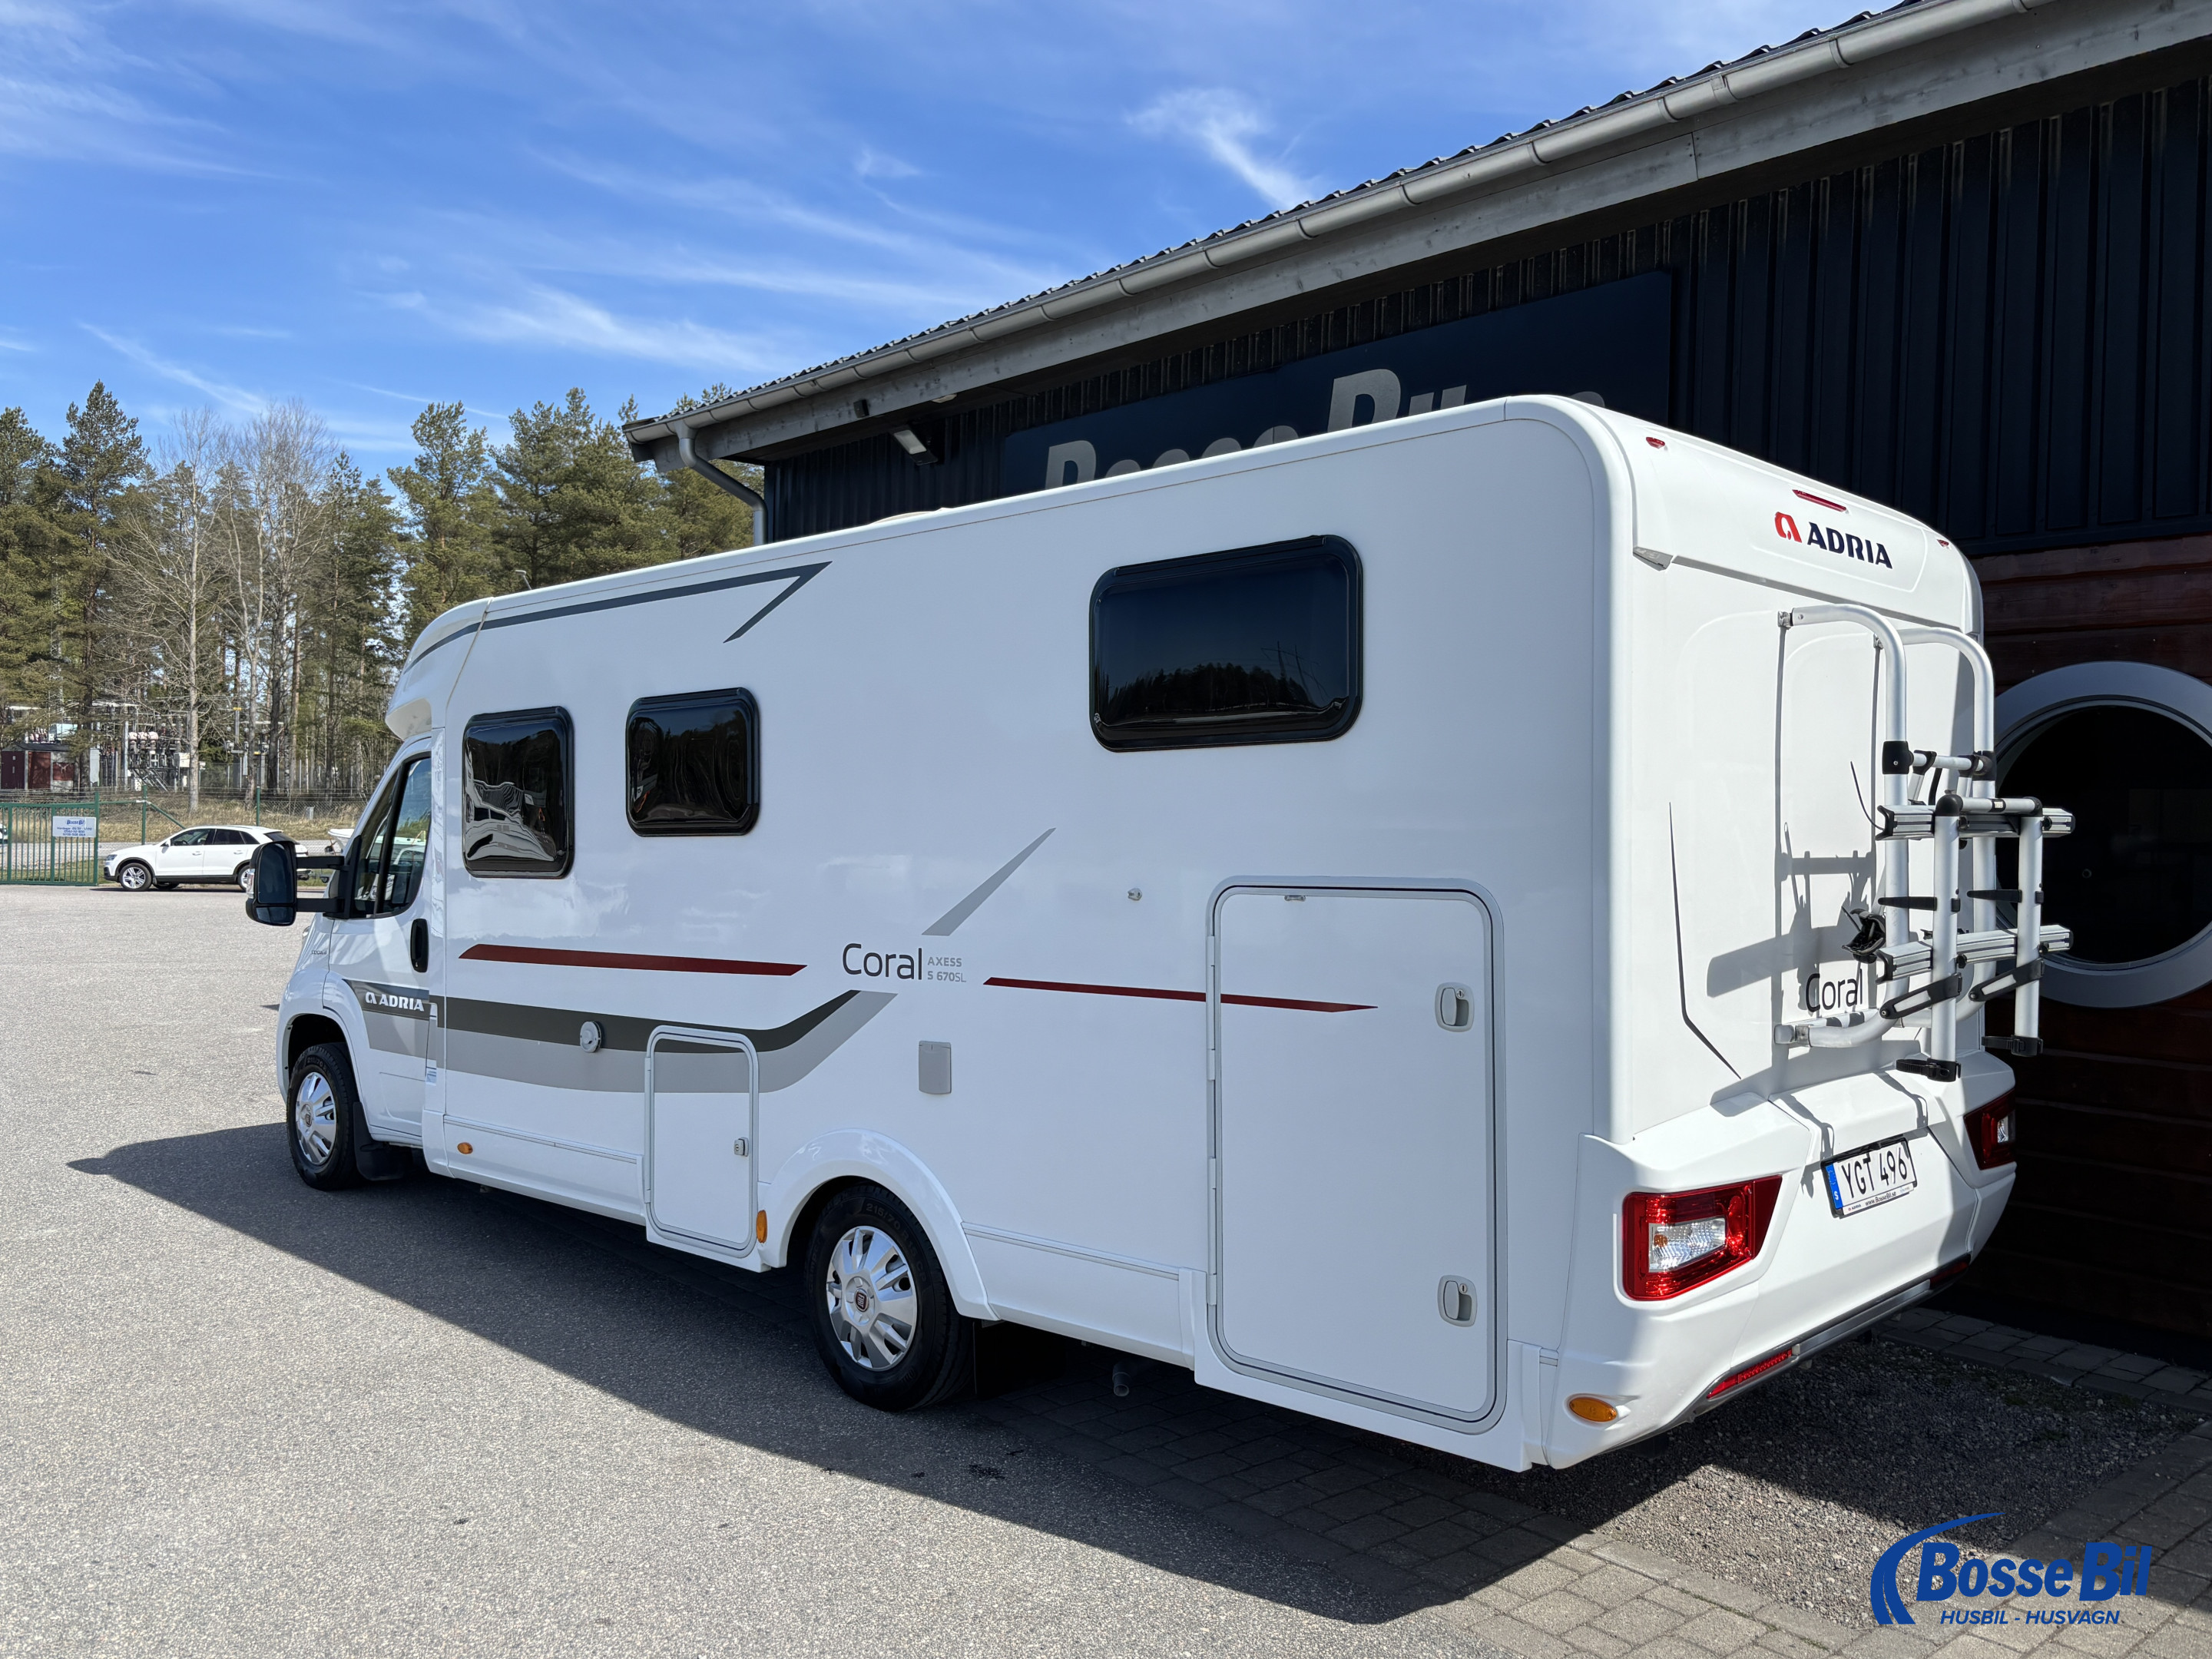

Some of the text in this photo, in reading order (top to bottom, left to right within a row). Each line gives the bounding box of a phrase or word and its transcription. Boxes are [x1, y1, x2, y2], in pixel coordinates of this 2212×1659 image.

[1806, 522, 1893, 569] ADRIA
[842, 942, 922, 981] Coral
[927, 956, 962, 968] AXESS
[927, 970, 967, 983] S 670SL
[1805, 968, 1863, 1012] Coral
[379, 993, 425, 1012] ADRIA
[1841, 1147, 1908, 1199] YGT 496
[1833, 1190, 1839, 1200] S
